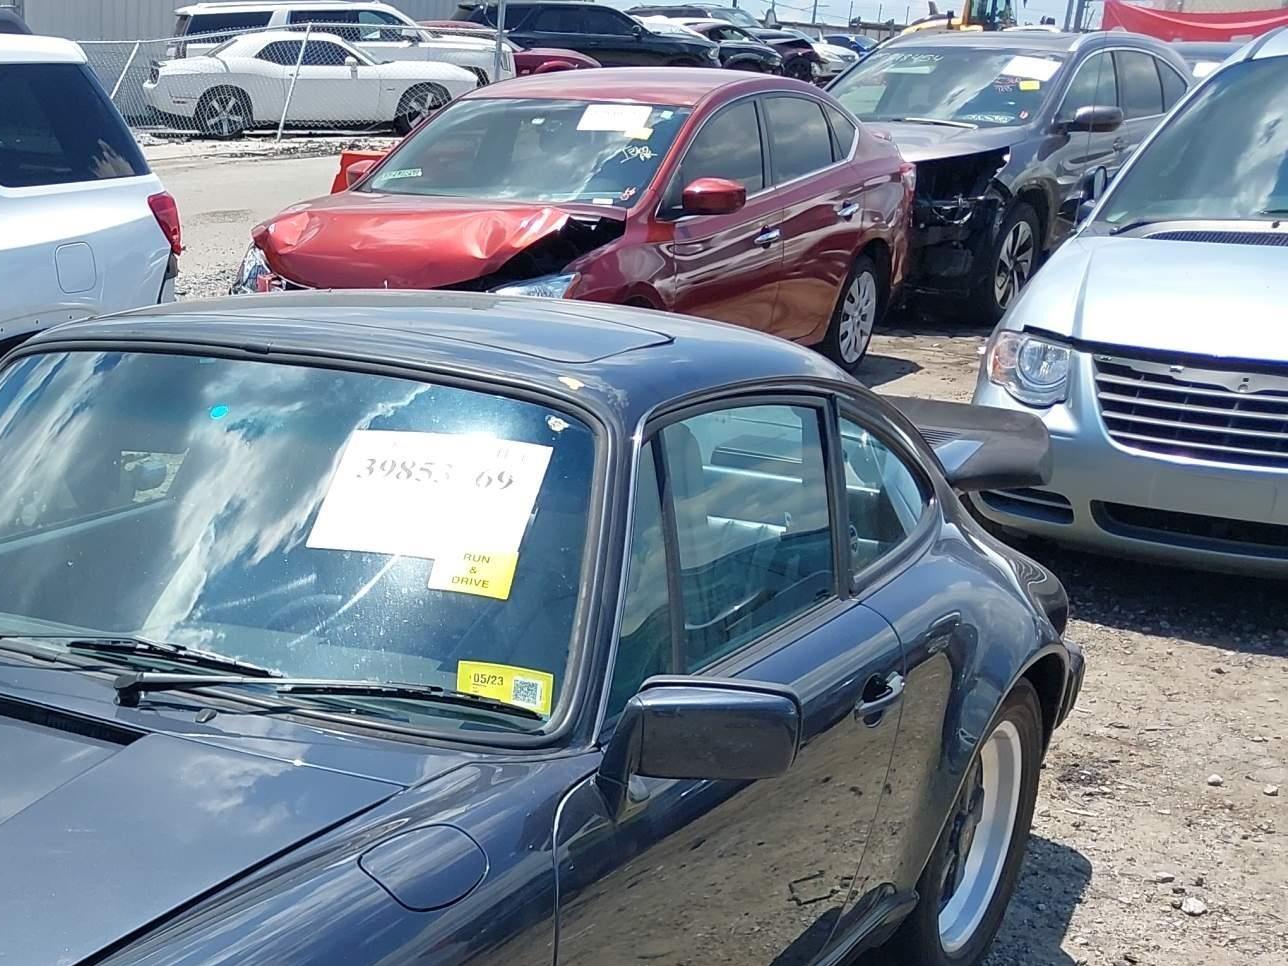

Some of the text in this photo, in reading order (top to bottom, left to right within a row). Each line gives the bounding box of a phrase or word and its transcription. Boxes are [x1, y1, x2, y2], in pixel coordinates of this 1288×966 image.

[356, 458, 515, 490] 3985369
[463, 552, 491, 564] RUN
[469, 566, 477, 574] &
[451, 575, 489, 589] DRIVE
[473, 673, 504, 686] 05/23
